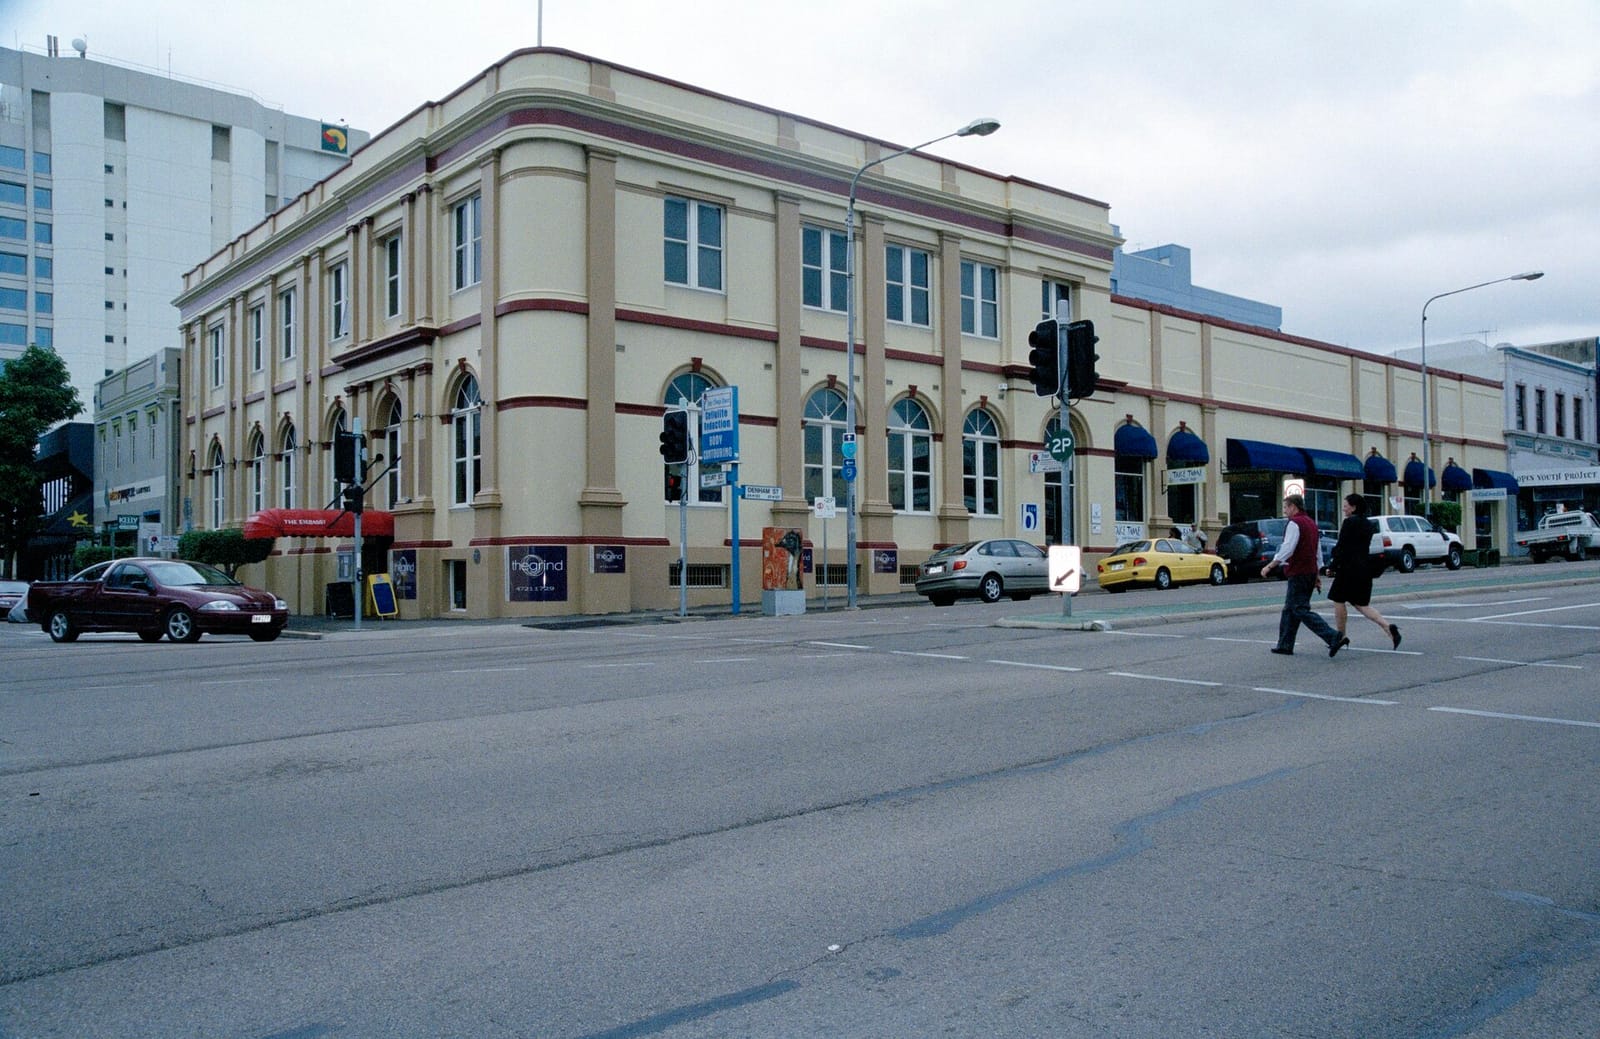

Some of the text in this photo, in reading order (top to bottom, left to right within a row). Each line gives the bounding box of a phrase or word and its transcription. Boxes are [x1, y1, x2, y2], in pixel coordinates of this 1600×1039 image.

[705, 409, 728, 420] Cellulite
[704, 419, 731, 430] Reduction
[709, 434, 723, 447] BODY
[1052, 438, 1071, 453] 2P
[1537, 472, 1561, 481] YOUTH
[512, 560, 563, 574] thegrind
